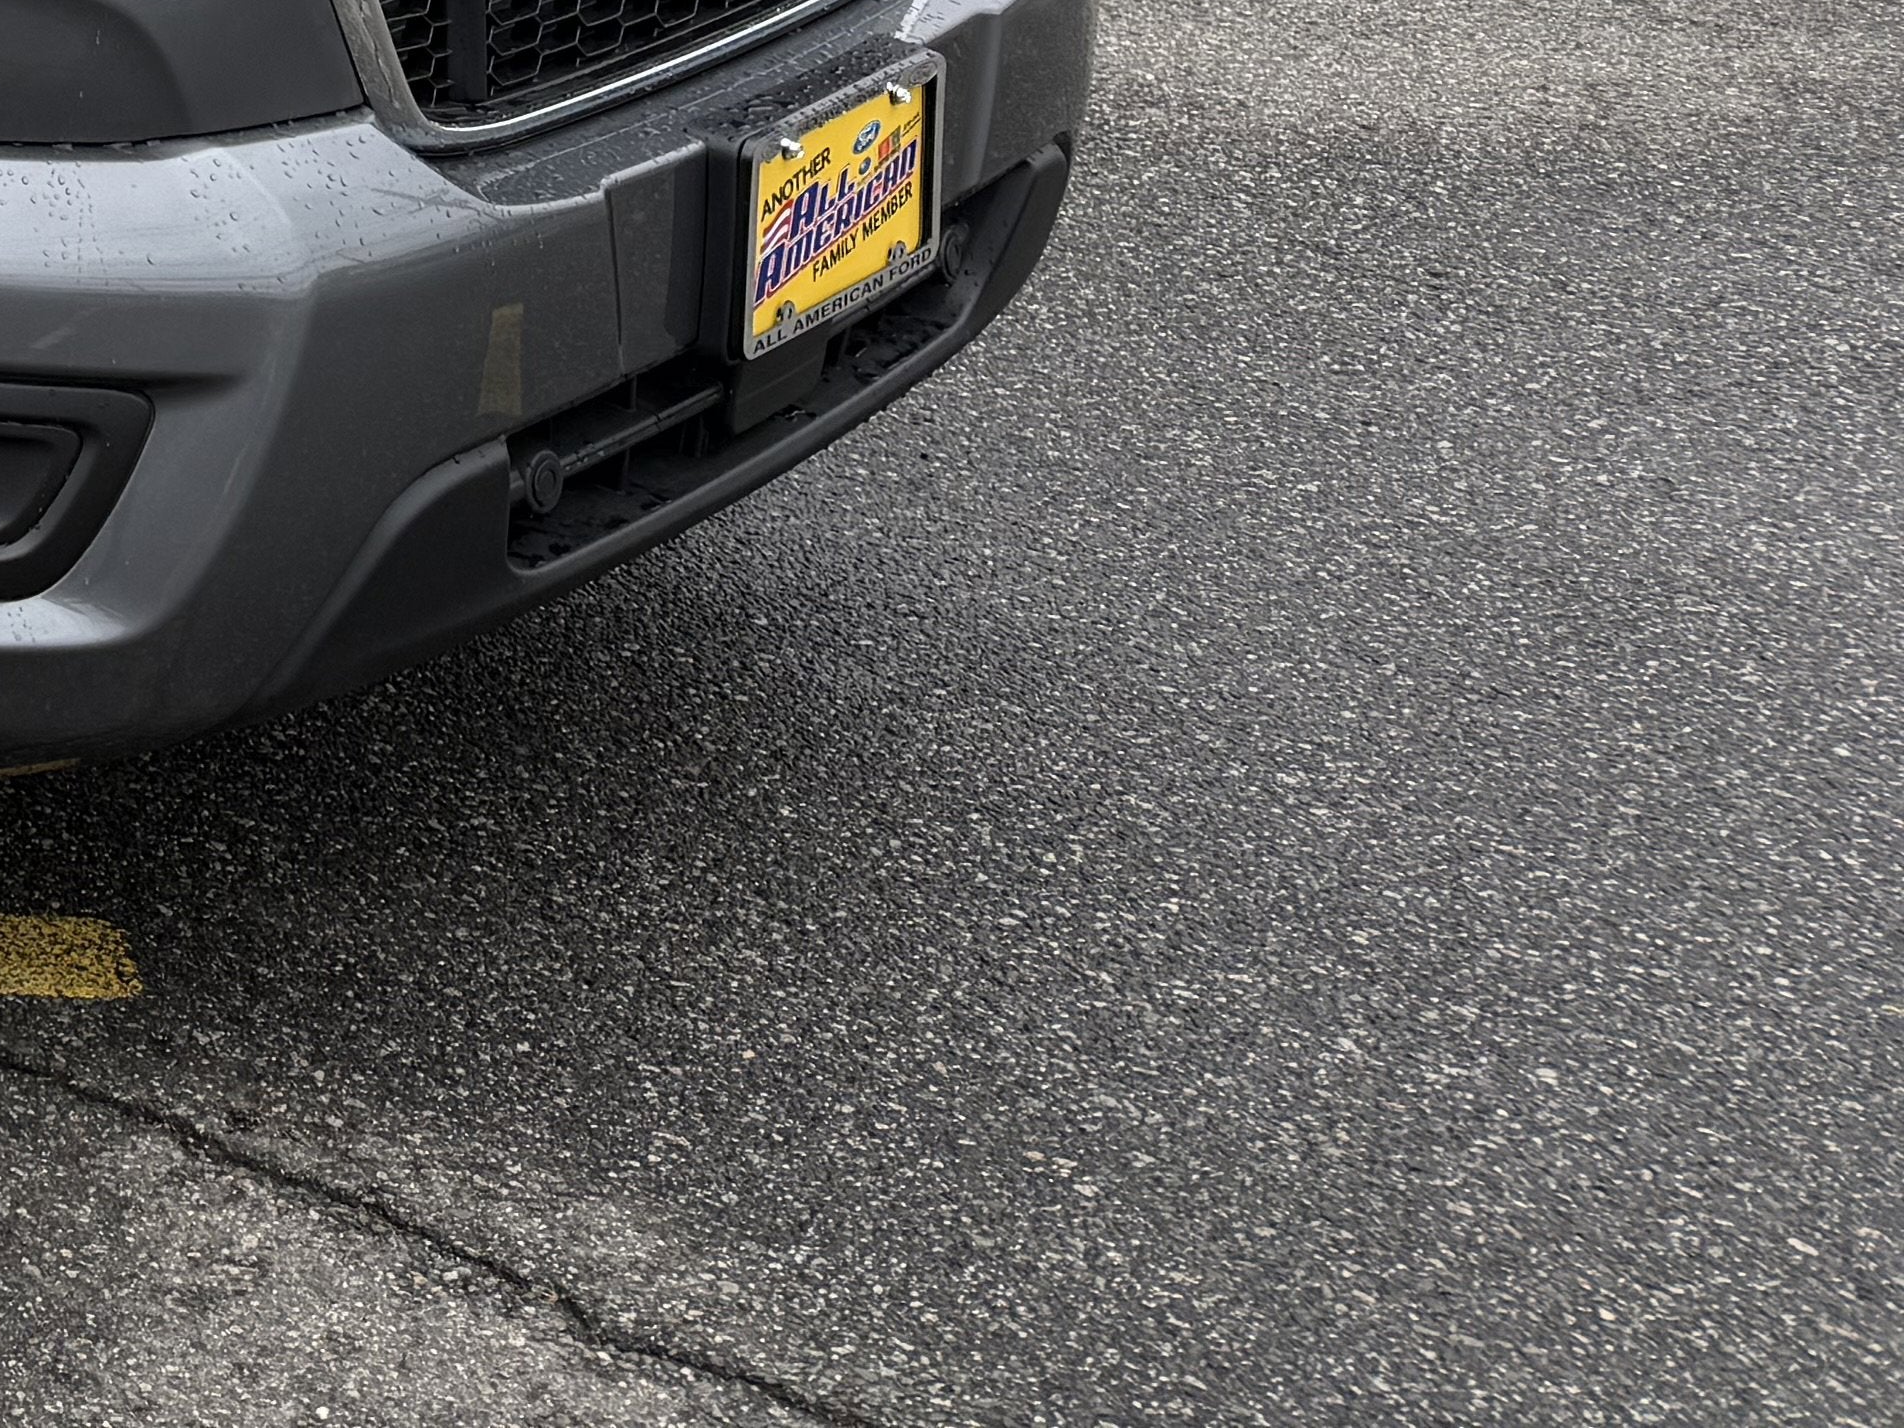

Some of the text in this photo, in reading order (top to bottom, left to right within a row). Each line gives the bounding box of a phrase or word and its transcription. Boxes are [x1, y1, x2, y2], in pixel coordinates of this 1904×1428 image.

[761, 147, 832, 223] ANOTHER
[812, 182, 913, 282] FAMILY MEMBER
[753, 247, 932, 354] ALL AMERICAN FORD
